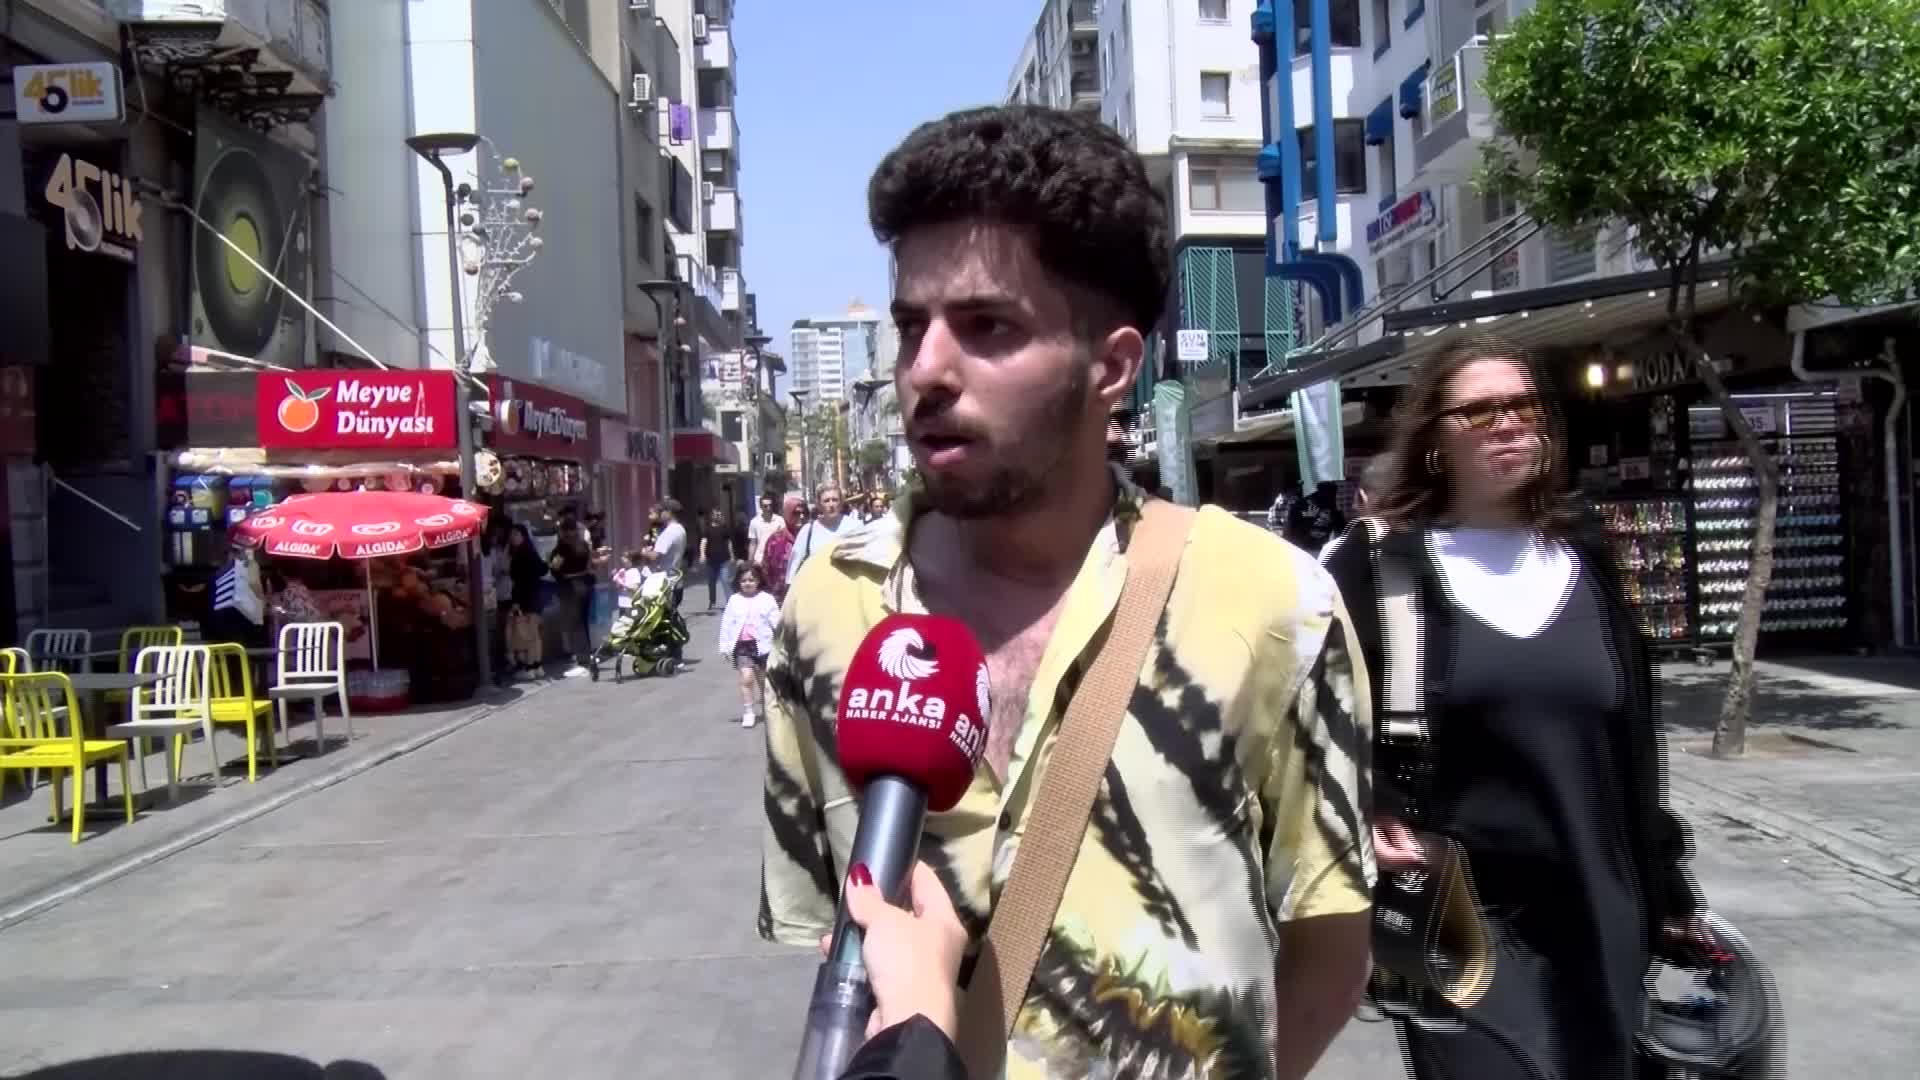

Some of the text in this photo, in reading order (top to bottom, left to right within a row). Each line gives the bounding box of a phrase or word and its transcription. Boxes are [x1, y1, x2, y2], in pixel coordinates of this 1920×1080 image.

[336, 380, 412, 409] Meyve
[336, 410, 434, 439] Dünyası
[848, 681, 946, 720] anka
[845, 709, 942, 729] HABER AJANSI
